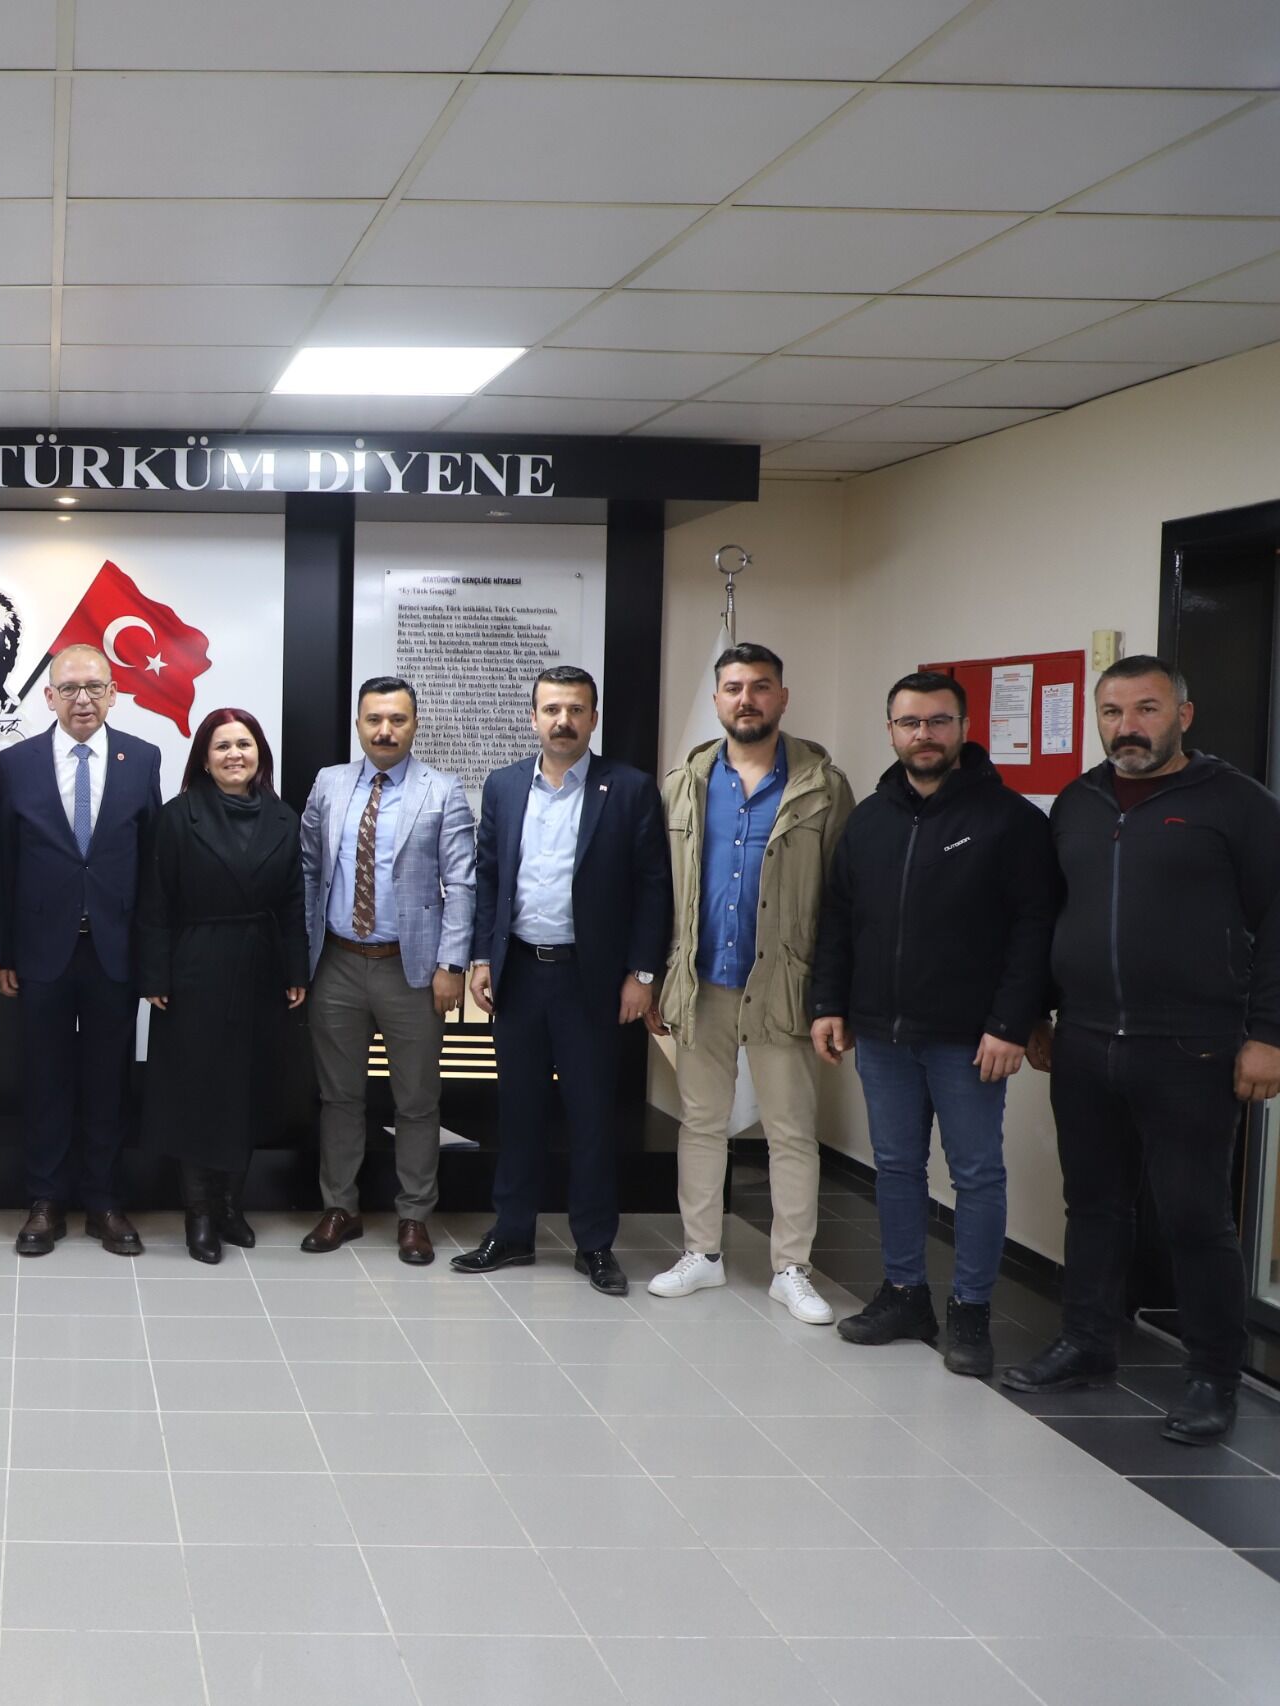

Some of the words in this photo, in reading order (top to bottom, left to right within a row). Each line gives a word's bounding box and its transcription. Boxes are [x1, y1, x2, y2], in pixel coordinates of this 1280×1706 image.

[304, 438, 555, 497] DİYENE
[462, 577, 491, 585] GENÇLİĞE
[493, 577, 521, 585] HİTABESİ
